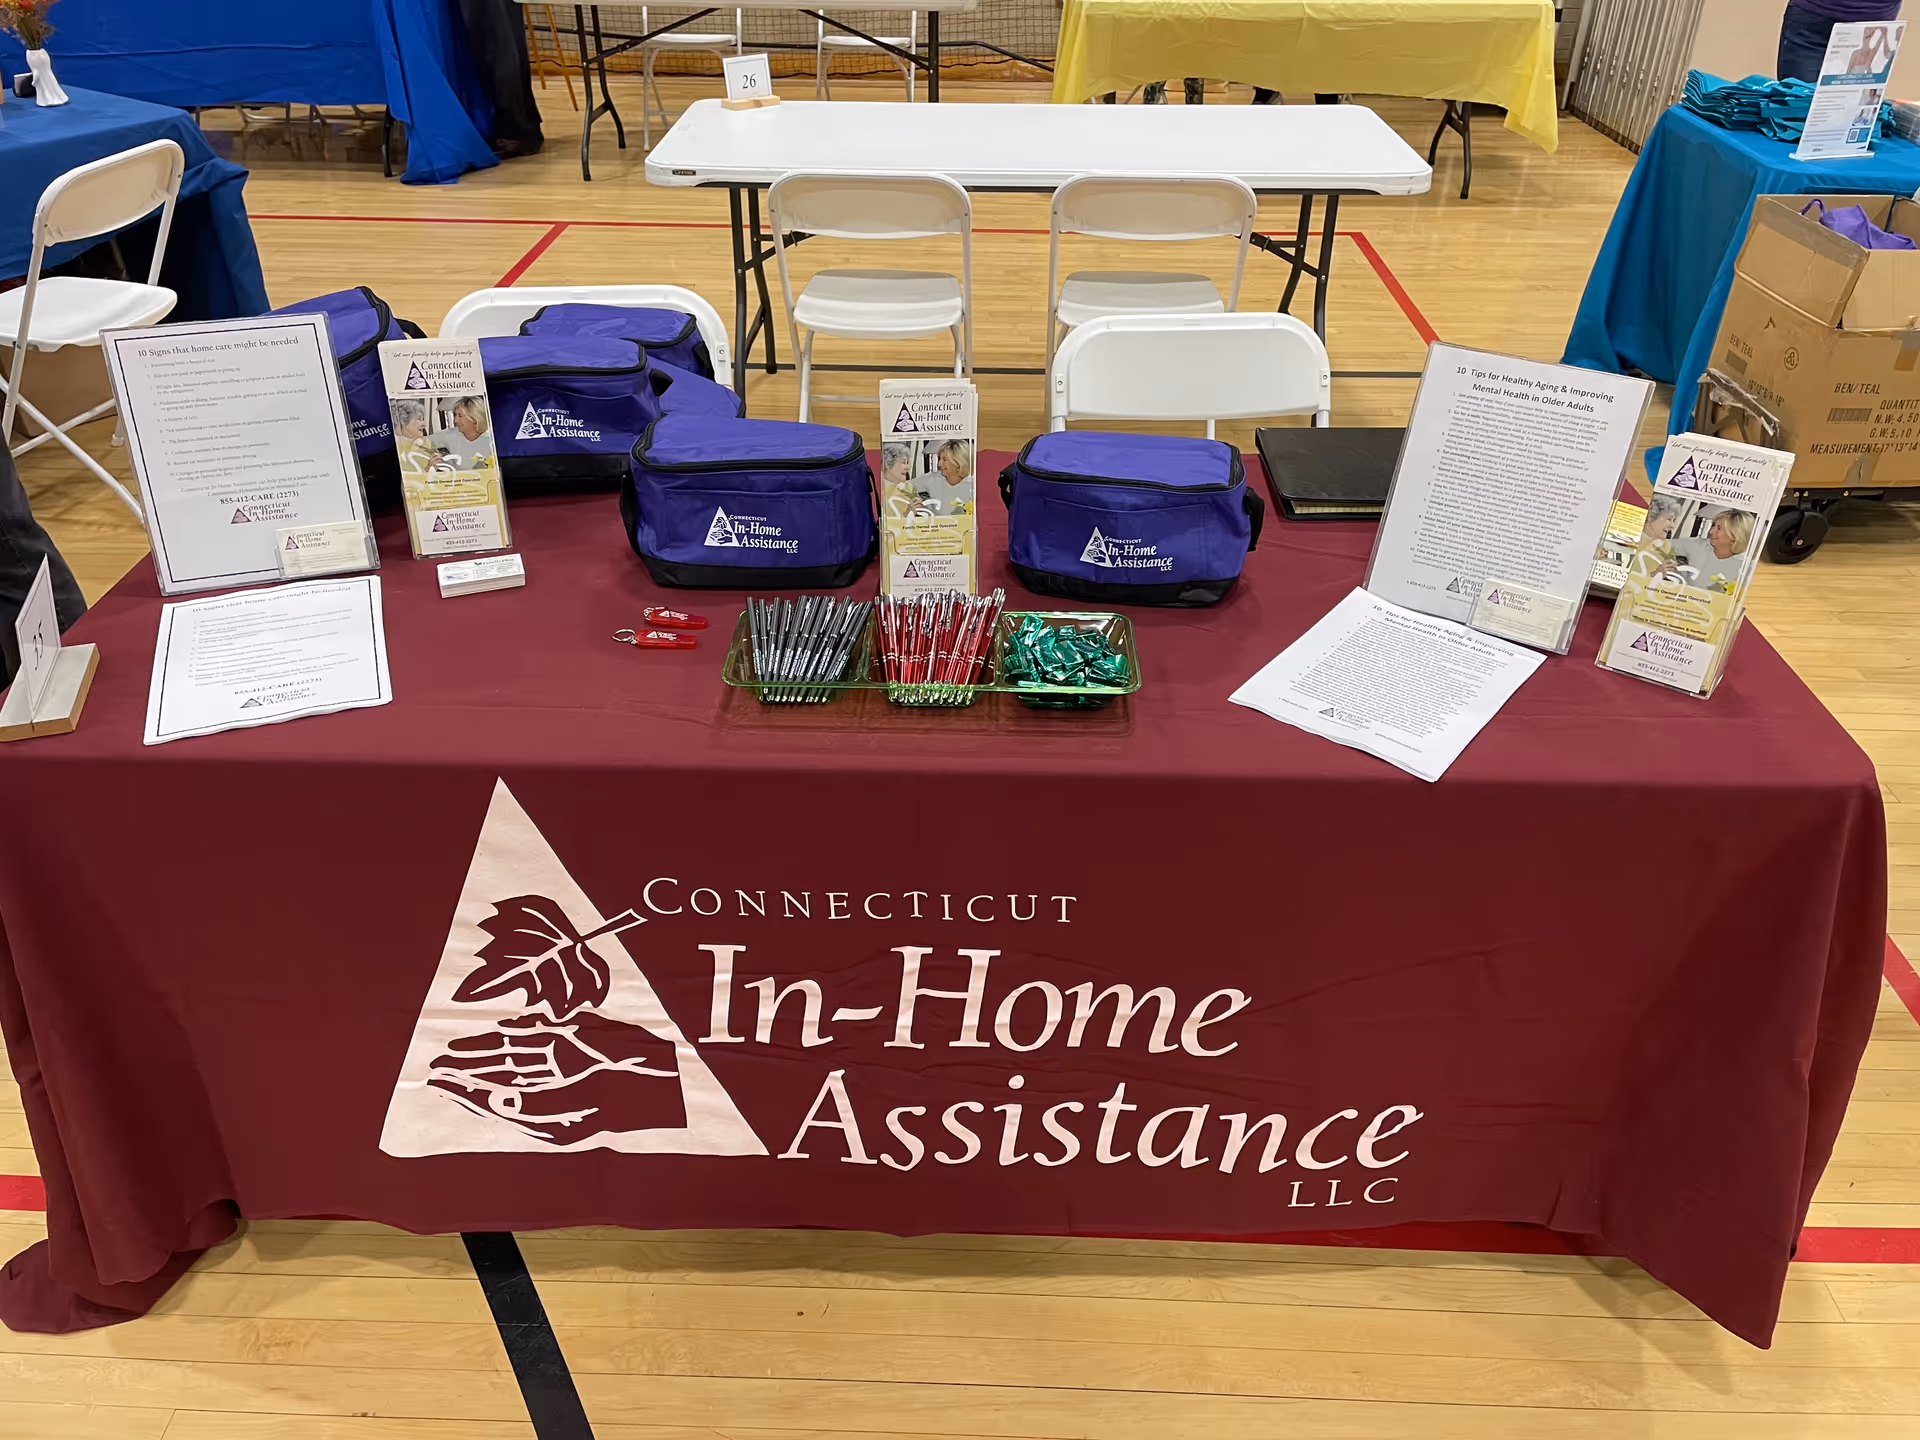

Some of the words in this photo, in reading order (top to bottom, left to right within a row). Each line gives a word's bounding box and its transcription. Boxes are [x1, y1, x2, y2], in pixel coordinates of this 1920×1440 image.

[742, 73, 757, 89] 26
[138, 350, 147, 358] 10
[149, 348, 171, 357] Signs
[172, 345, 189, 354] that
[191, 343, 213, 352] home
[234, 340, 257, 350] might
[259, 339, 268, 347] be
[271, 337, 299, 346] needed
[421, 360, 472, 370] Connecticut
[426, 371, 462, 380] In-Home
[432, 381, 475, 389] Assistance
[1456, 366, 1466, 375] 10
[1471, 368, 1486, 380] Tips
[1488, 371, 1500, 380] for
[1501, 375, 1533, 389] Healthy
[1535, 381, 1559, 393] Aging
[1560, 385, 1568, 393] &
[1570, 387, 1614, 403] Improving
[1860, 384, 1880, 394] TEAL
[1472, 383, 1501, 395] Mental
[1503, 389, 1530, 401] Health
[1532, 394, 1540, 402] in
[1541, 397, 1565, 407] Older
[1566, 401, 1594, 413] Adults
[1880, 399, 1920, 409] QUANTIT
[912, 402, 962, 412] Connecticut
[542, 414, 584, 427] In-Home
[915, 412, 951, 421] In-Home
[354, 423, 389, 440] stance
[549, 426, 600, 438] Assistance
[920, 423, 963, 432] Assistance
[1715, 450, 1728, 458] help
[1698, 459, 1760, 480] Connecticut
[1698, 471, 1743, 488] In-Home
[220, 493, 275, 505] 855-412-CARE
[276, 491, 299, 499] (2273)
[1700, 483, 1754, 502] Assistance
[243, 501, 290, 511] Connecticut
[249, 507, 285, 516] In-Home
[255, 512, 298, 522] Assistance
[441, 511, 480, 519] Connecticut
[446, 517, 475, 525] In-Home
[451, 523, 485, 531] Assistance
[734, 521, 782, 536] In-Home
[741, 535, 798, 549] Assistance
[1107, 543, 1157, 556] In-Home
[1114, 557, 1173, 568] Assistance
[1459, 576, 1484, 588] Connect
[1461, 582, 1482, 592] In-Ho
[1462, 588, 1480, 598] Assis
[1498, 588, 1532, 602] Connecticut
[1502, 602, 1532, 613] Assistance
[1384, 617, 1411, 629] Mental
[1411, 626, 1437, 637] Health
[1447, 638, 1469, 648] Older
[1470, 645, 1495, 657] Adults
[1385, 610, 1400, 618] Tips
[1413, 620, 1442, 631] Healthy
[1443, 629, 1465, 639] Aging
[1474, 640, 1515, 657] Improving
[1648, 631, 1693, 650] Connecticut
[1650, 640, 1685, 655] In-Home
[1652, 648, 1692, 665] Assistance
[642, 876, 1078, 924] CONNECTICUT
[697, 943, 1253, 1057] In-Home
[777, 1069, 1425, 1176] Assistance
[1287, 1177, 1400, 1209] LLC
